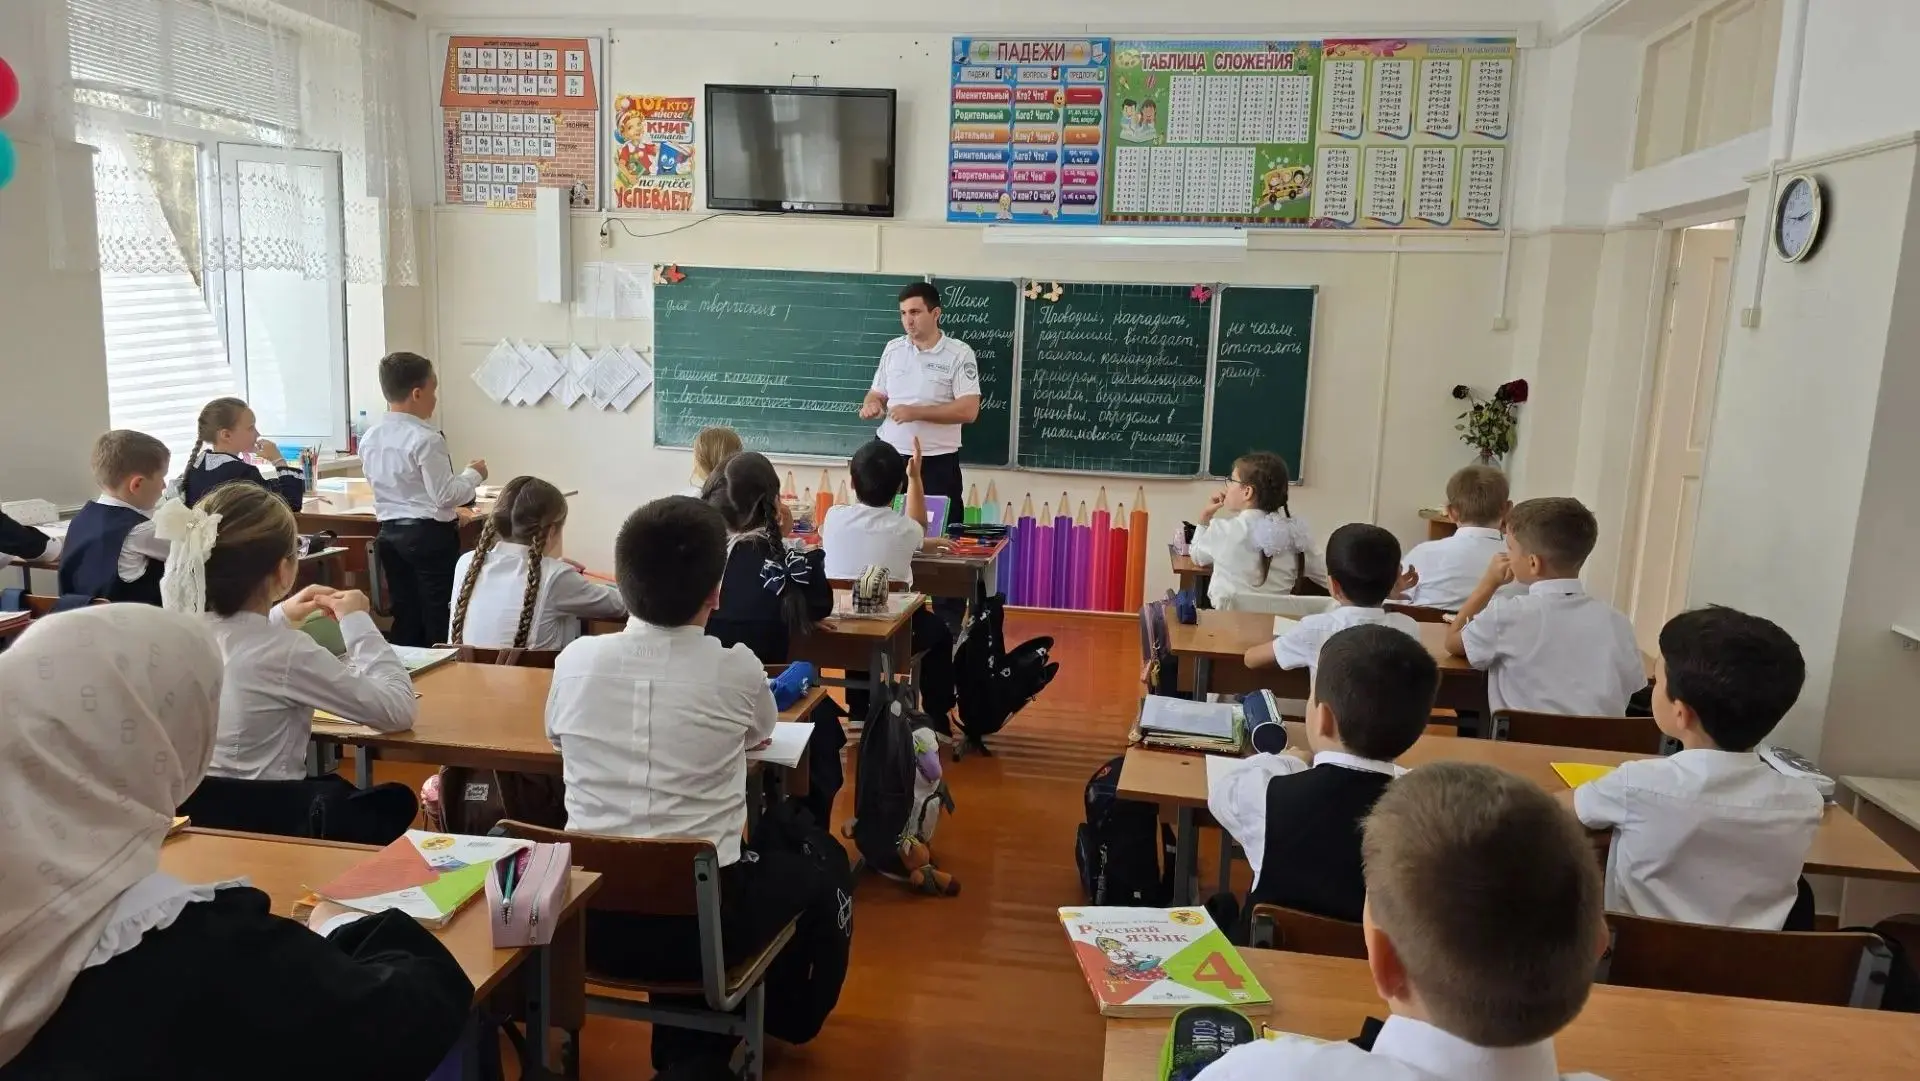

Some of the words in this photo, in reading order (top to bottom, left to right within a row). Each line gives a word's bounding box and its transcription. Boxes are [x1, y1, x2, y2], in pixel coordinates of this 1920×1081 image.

[998, 43, 1065, 64] ПАДЕЖИ
[1142, 53, 1205, 71] ТАБЛИЦА
[1214, 53, 1294, 69] СЛОЖЕНИЯ
[955, 90, 1009, 100] Именительный
[1016, 91, 1031, 100] Кто?
[1033, 90, 1048, 100] Что?
[667, 101, 689, 110] КТО
[955, 109, 1004, 120] Родительный
[1016, 110, 1033, 120] Кого?
[1036, 109, 1054, 120] Чего?
[647, 122, 690, 134] КНИГ
[954, 150, 1002, 160] Винительный
[954, 169, 1005, 181] Творительный
[614, 187, 693, 211] УСПЕВАЕТ!
[953, 189, 999, 200] Предложный
[944, 285, 990, 308] Такое
[1220, 342, 1303, 356] отстоять
[1078, 924, 1161, 935] Русский
[1192, 951, 1247, 990] 4
